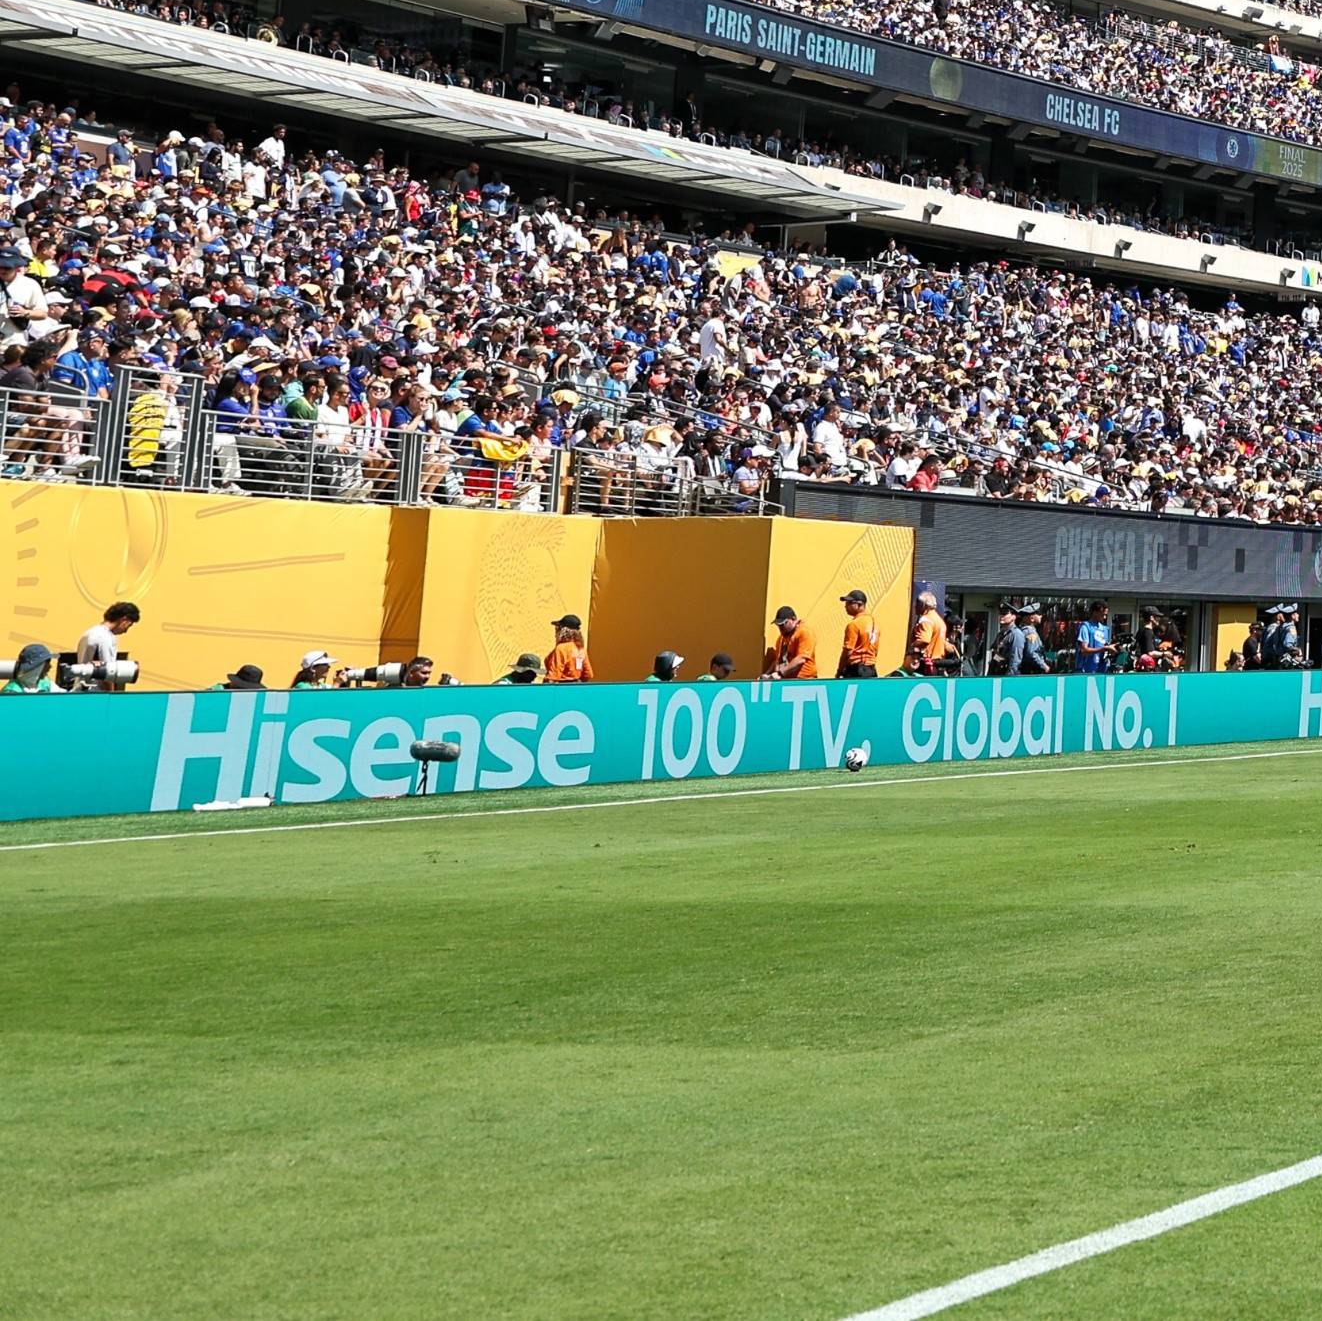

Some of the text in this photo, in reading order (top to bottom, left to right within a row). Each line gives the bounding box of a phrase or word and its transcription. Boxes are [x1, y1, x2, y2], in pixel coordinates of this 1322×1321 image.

[705, 4, 876, 77] PARIS SAINT-GERMAIN
[1046, 92, 1119, 136] CHELSEA FC
[1278, 145, 1306, 165] FINAL
[1280, 161, 1303, 178] 2025
[1054, 526, 1164, 583] CHELSEA FC
[150, 690, 596, 811] Hisense
[902, 676, 1063, 763] Global
